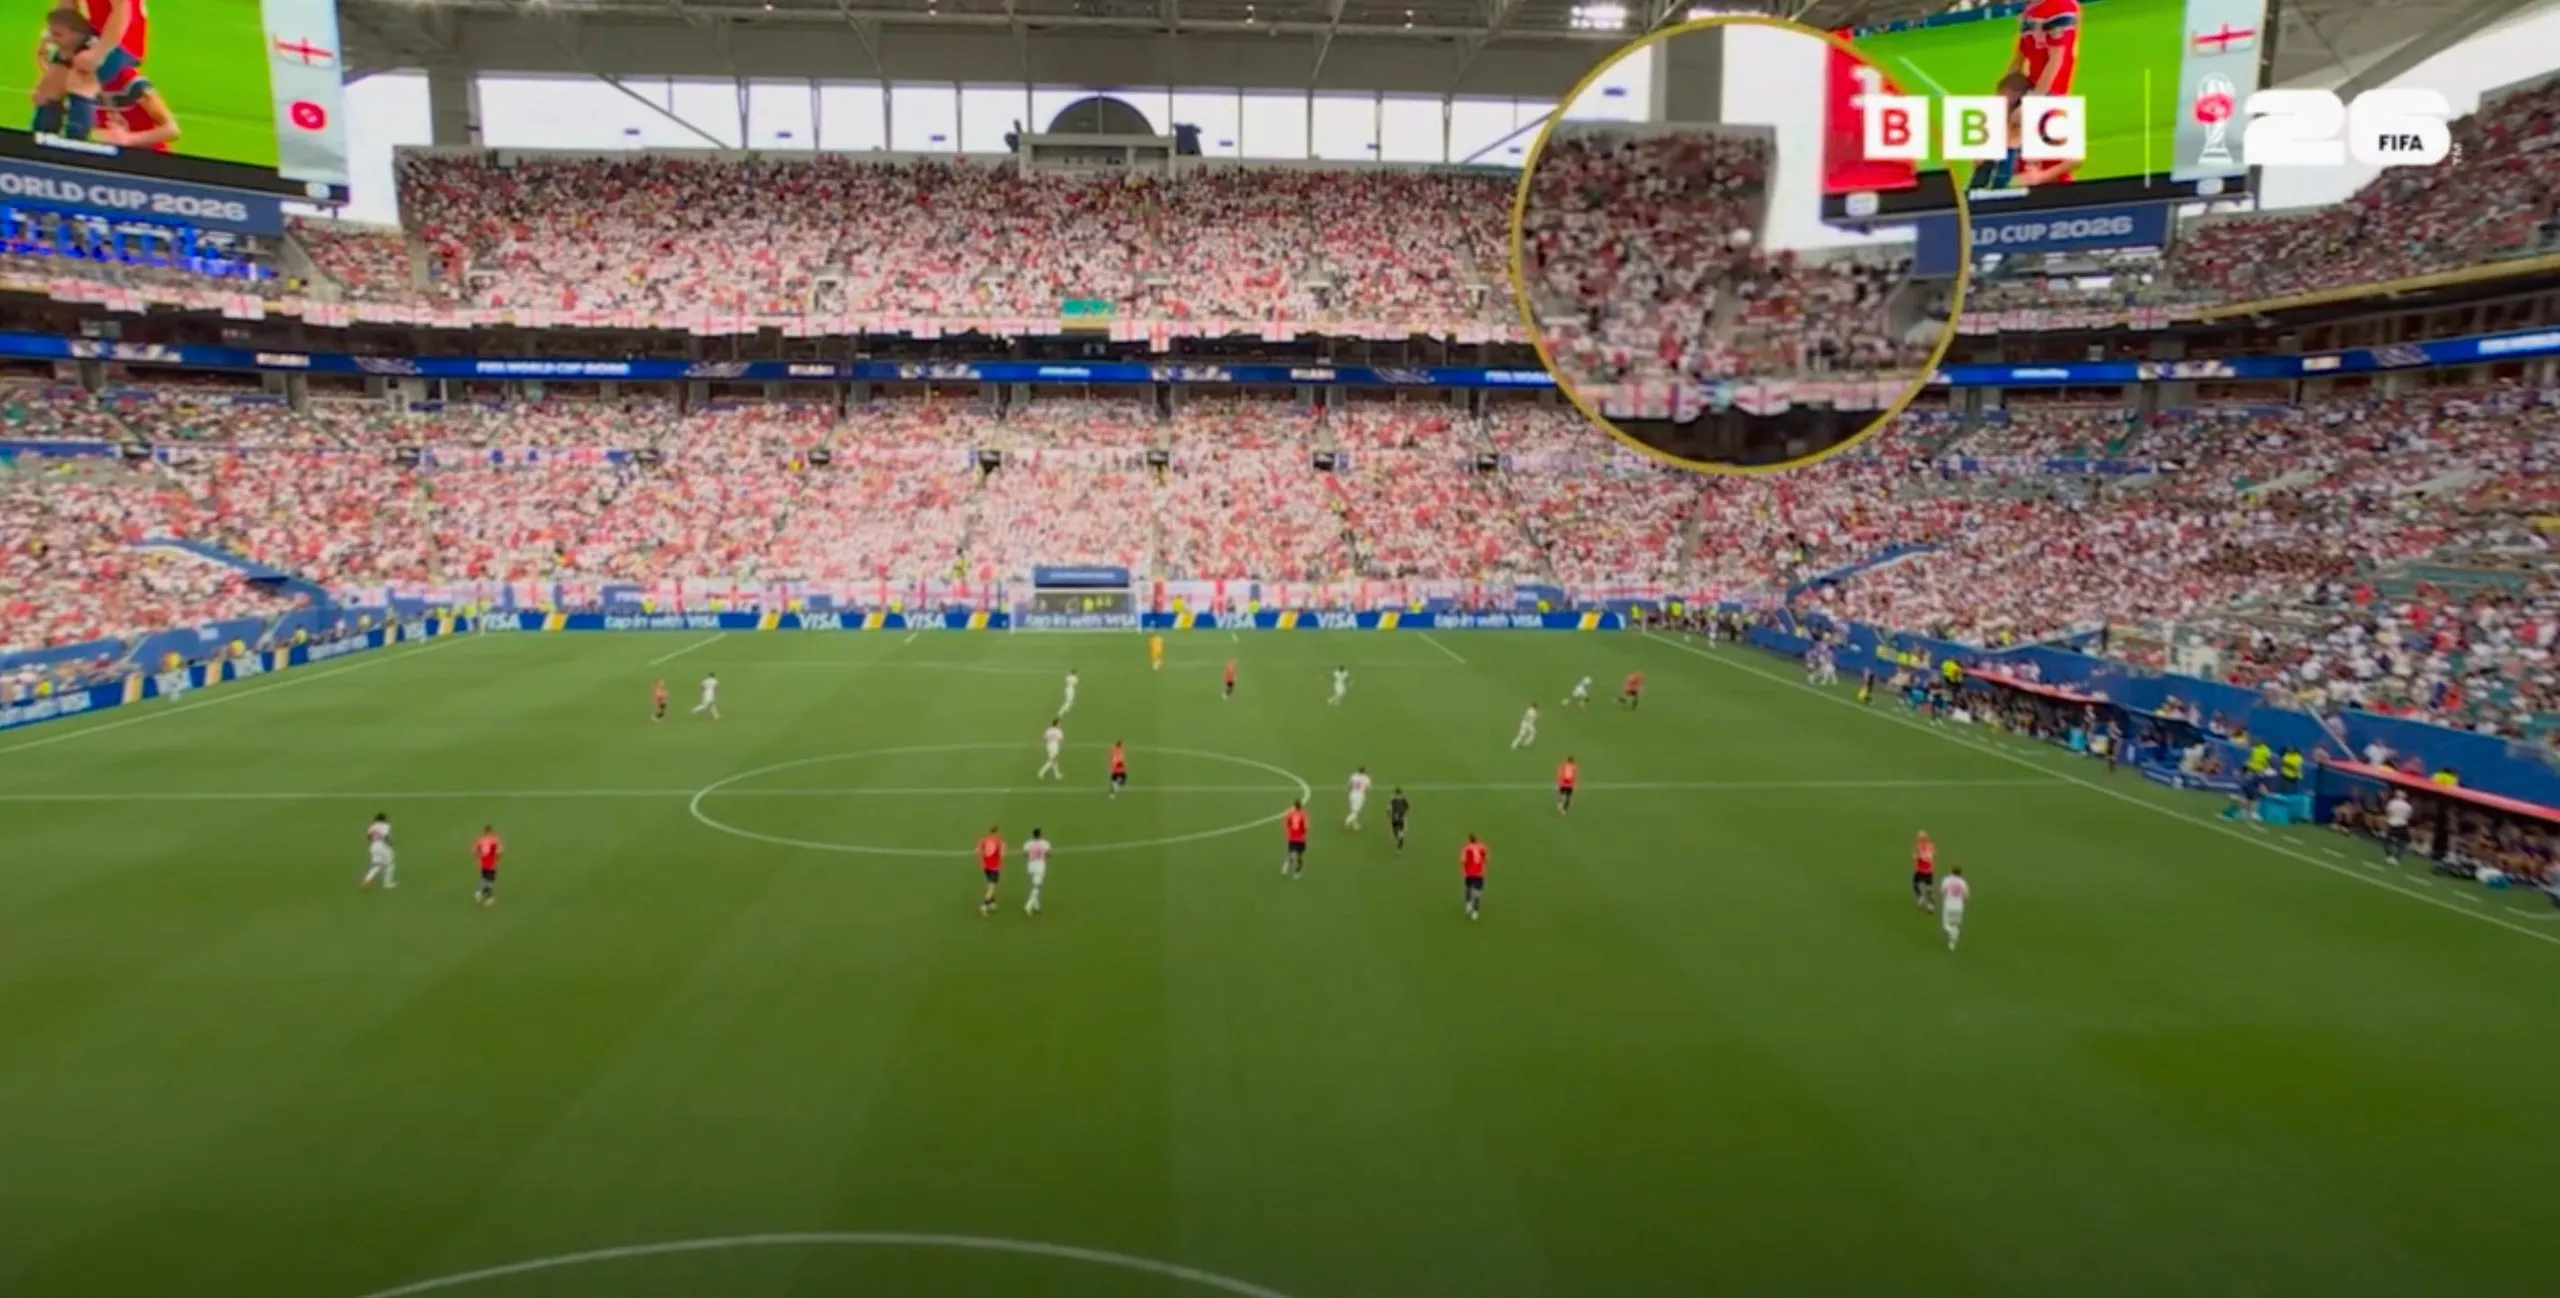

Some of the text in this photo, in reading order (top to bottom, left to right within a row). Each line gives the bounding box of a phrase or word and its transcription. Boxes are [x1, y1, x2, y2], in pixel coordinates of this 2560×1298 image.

[89, 182, 149, 210] CUP
[152, 193, 248, 222] 2026
[2001, 223, 2047, 244] CUP
[2050, 215, 2133, 240] 2026
[799, 612, 842, 629] VISA
[903, 612, 947, 629] VISA
[1215, 612, 1255, 629] VISA
[1316, 612, 1358, 629] VISA
